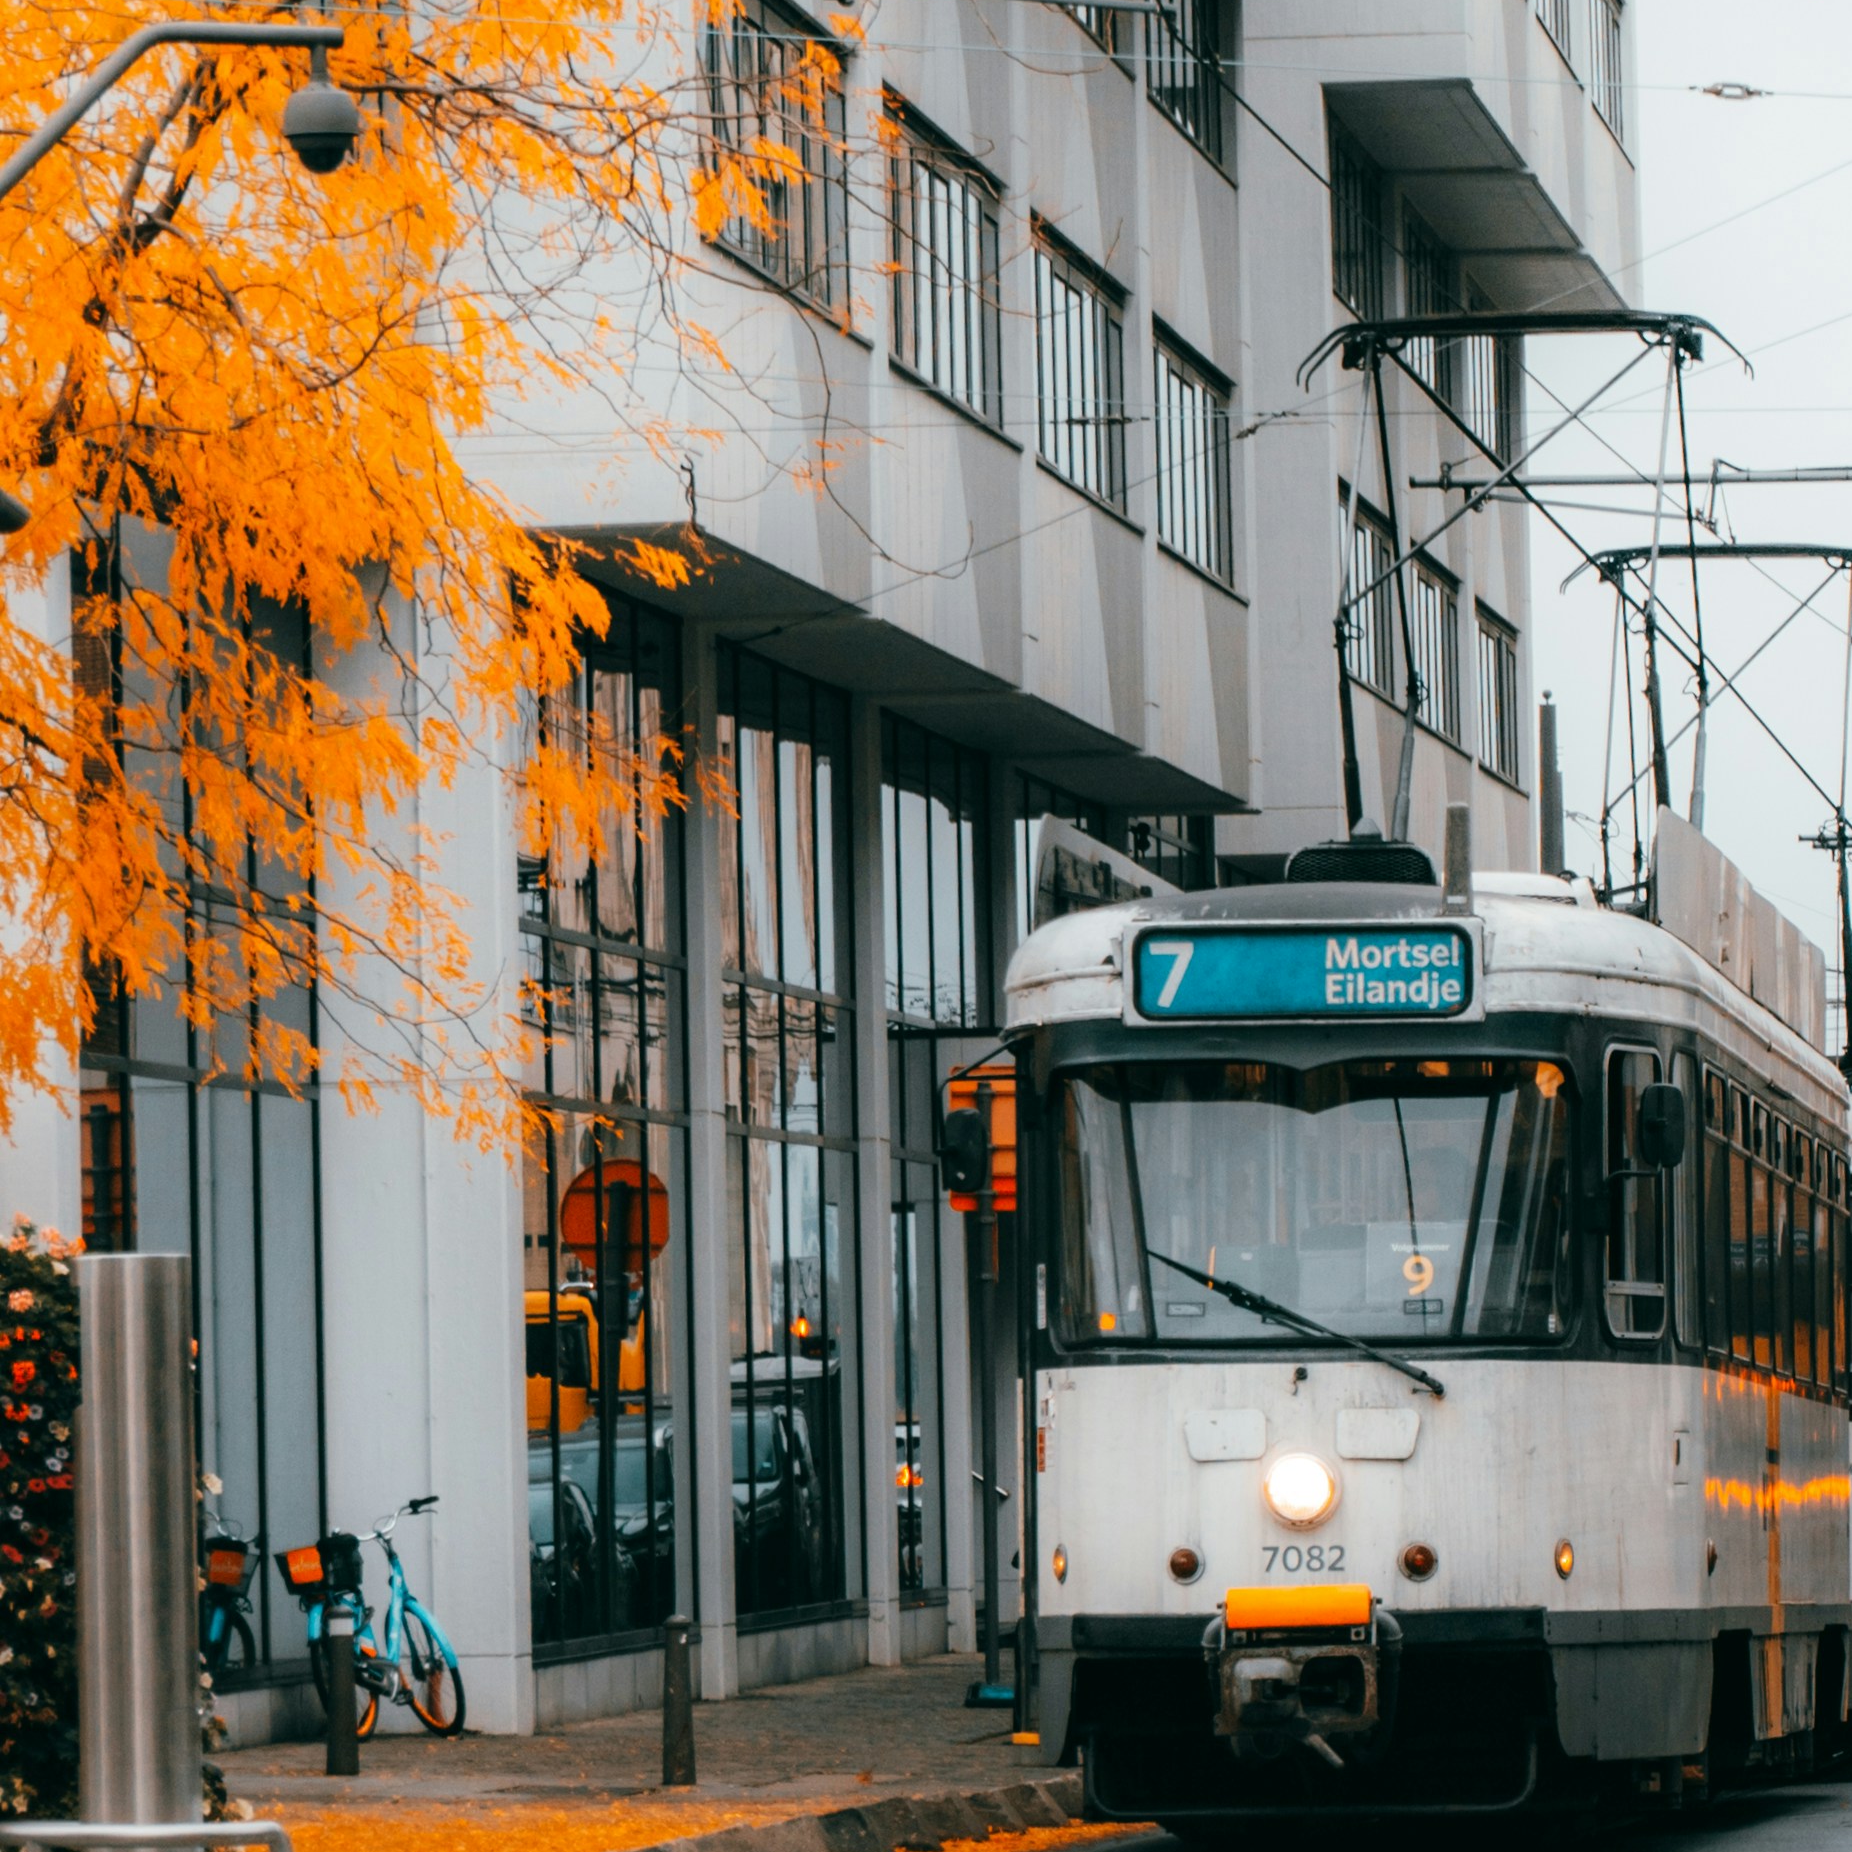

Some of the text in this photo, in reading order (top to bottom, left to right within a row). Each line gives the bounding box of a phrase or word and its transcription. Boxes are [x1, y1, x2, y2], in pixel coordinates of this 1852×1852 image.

[1324, 935, 1460, 969] Mortsel
[1149, 942, 1194, 1008] 7
[1324, 971, 1461, 1009] Eilandje
[1402, 1254, 1434, 1296] 9
[1261, 1545, 1345, 1573] 7082
